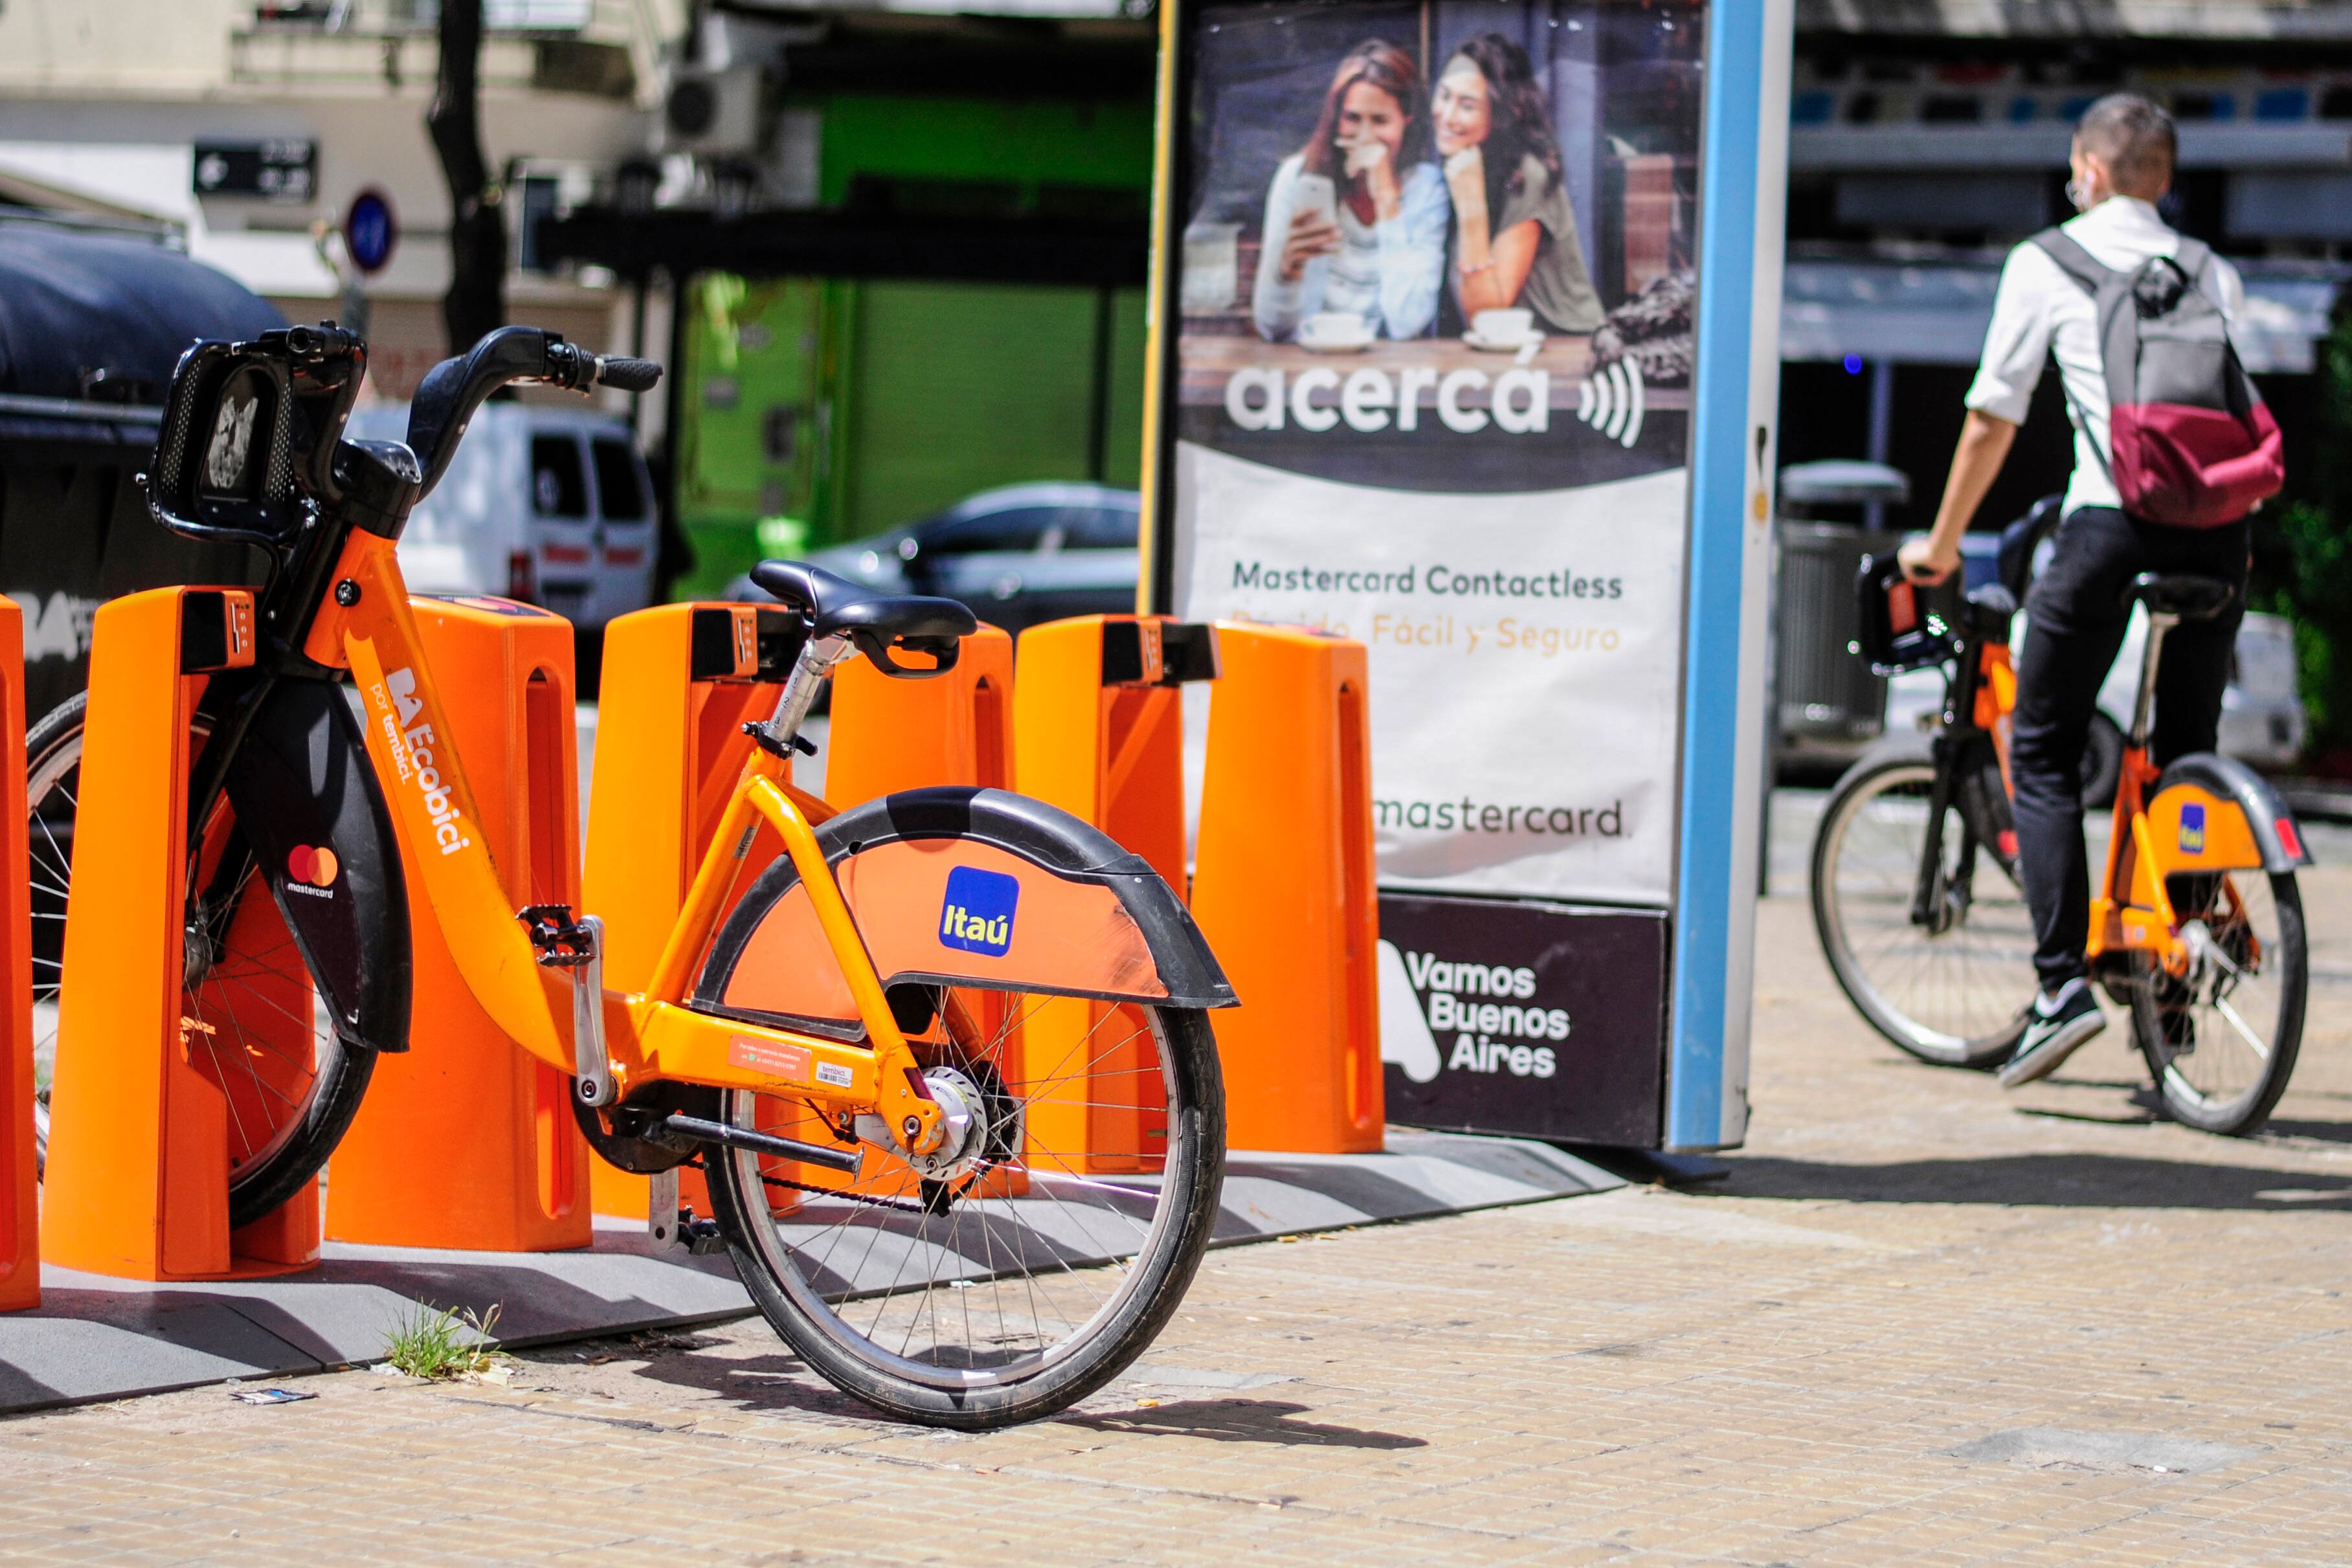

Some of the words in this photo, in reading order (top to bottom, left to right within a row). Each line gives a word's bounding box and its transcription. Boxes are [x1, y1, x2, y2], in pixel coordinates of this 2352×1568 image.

[1224, 343, 1549, 433] acercá
[1232, 561, 1415, 594] Mastercard
[1426, 565, 1623, 599] Contactless
[1372, 612, 1453, 645] Fácil
[1465, 625, 1484, 654] y
[1497, 617, 1620, 658] Seguro
[370, 682, 388, 710] por
[404, 722, 470, 855] Ecobici
[287, 882, 333, 899] mastercard
[943, 904, 1009, 946] Itaú
[1406, 950, 1536, 999] Vamos
[1428, 991, 1571, 1040] Buenos
[1448, 1033, 1556, 1079] Aires
